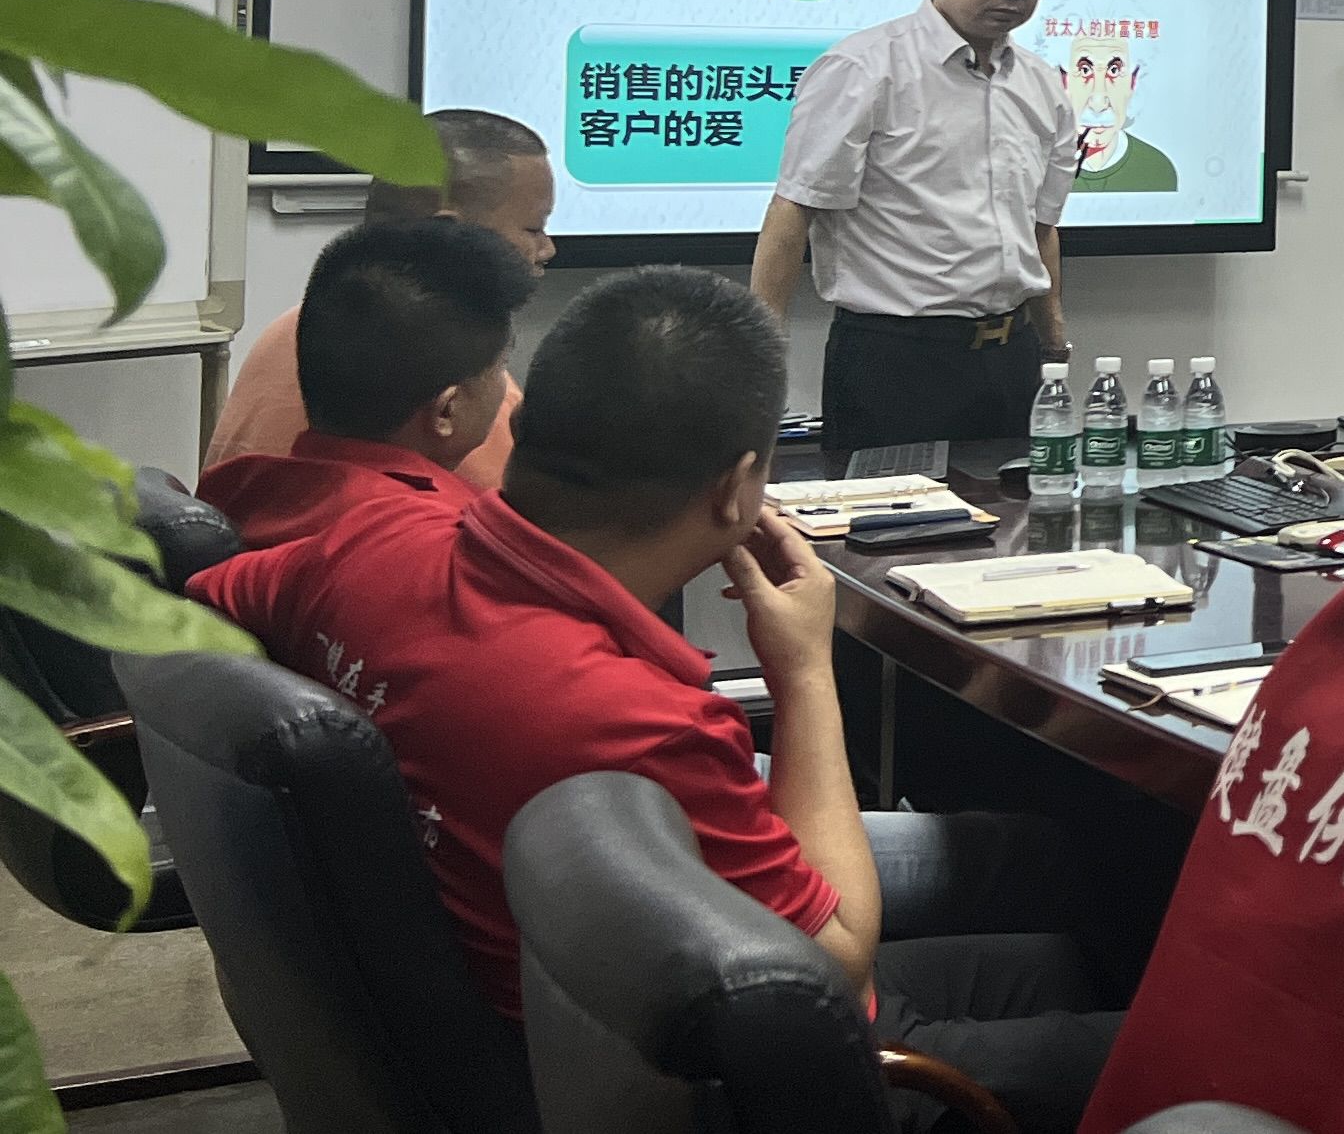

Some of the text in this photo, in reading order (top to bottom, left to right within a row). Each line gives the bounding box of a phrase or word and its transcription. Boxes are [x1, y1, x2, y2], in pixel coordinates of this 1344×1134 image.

[1045, 17, 1160, 40] 犹太人的财富智慧
[579, 110, 744, 148] 客户的爱
